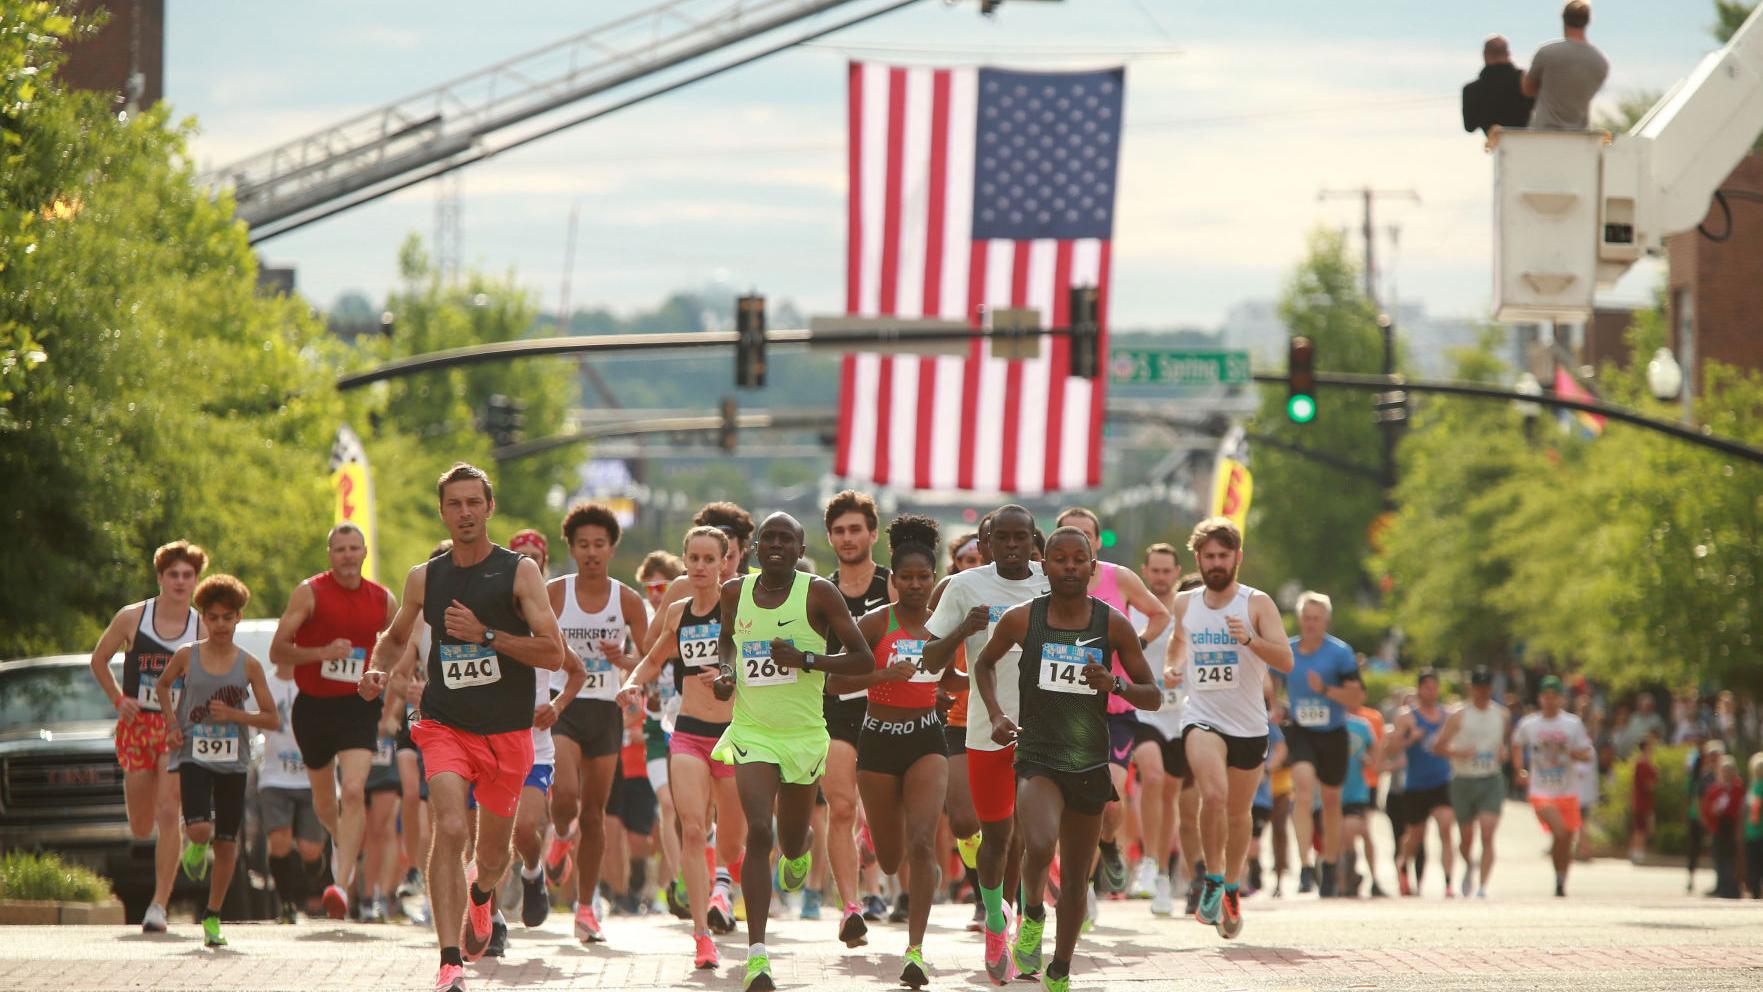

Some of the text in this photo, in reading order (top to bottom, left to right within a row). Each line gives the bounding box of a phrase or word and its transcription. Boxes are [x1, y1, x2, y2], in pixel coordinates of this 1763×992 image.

[684, 641, 719, 659] 322
[447, 659, 493, 680] 440
[1197, 666, 1234, 683] 248
[879, 720, 915, 736] PRO
[197, 740, 233, 755] 391
